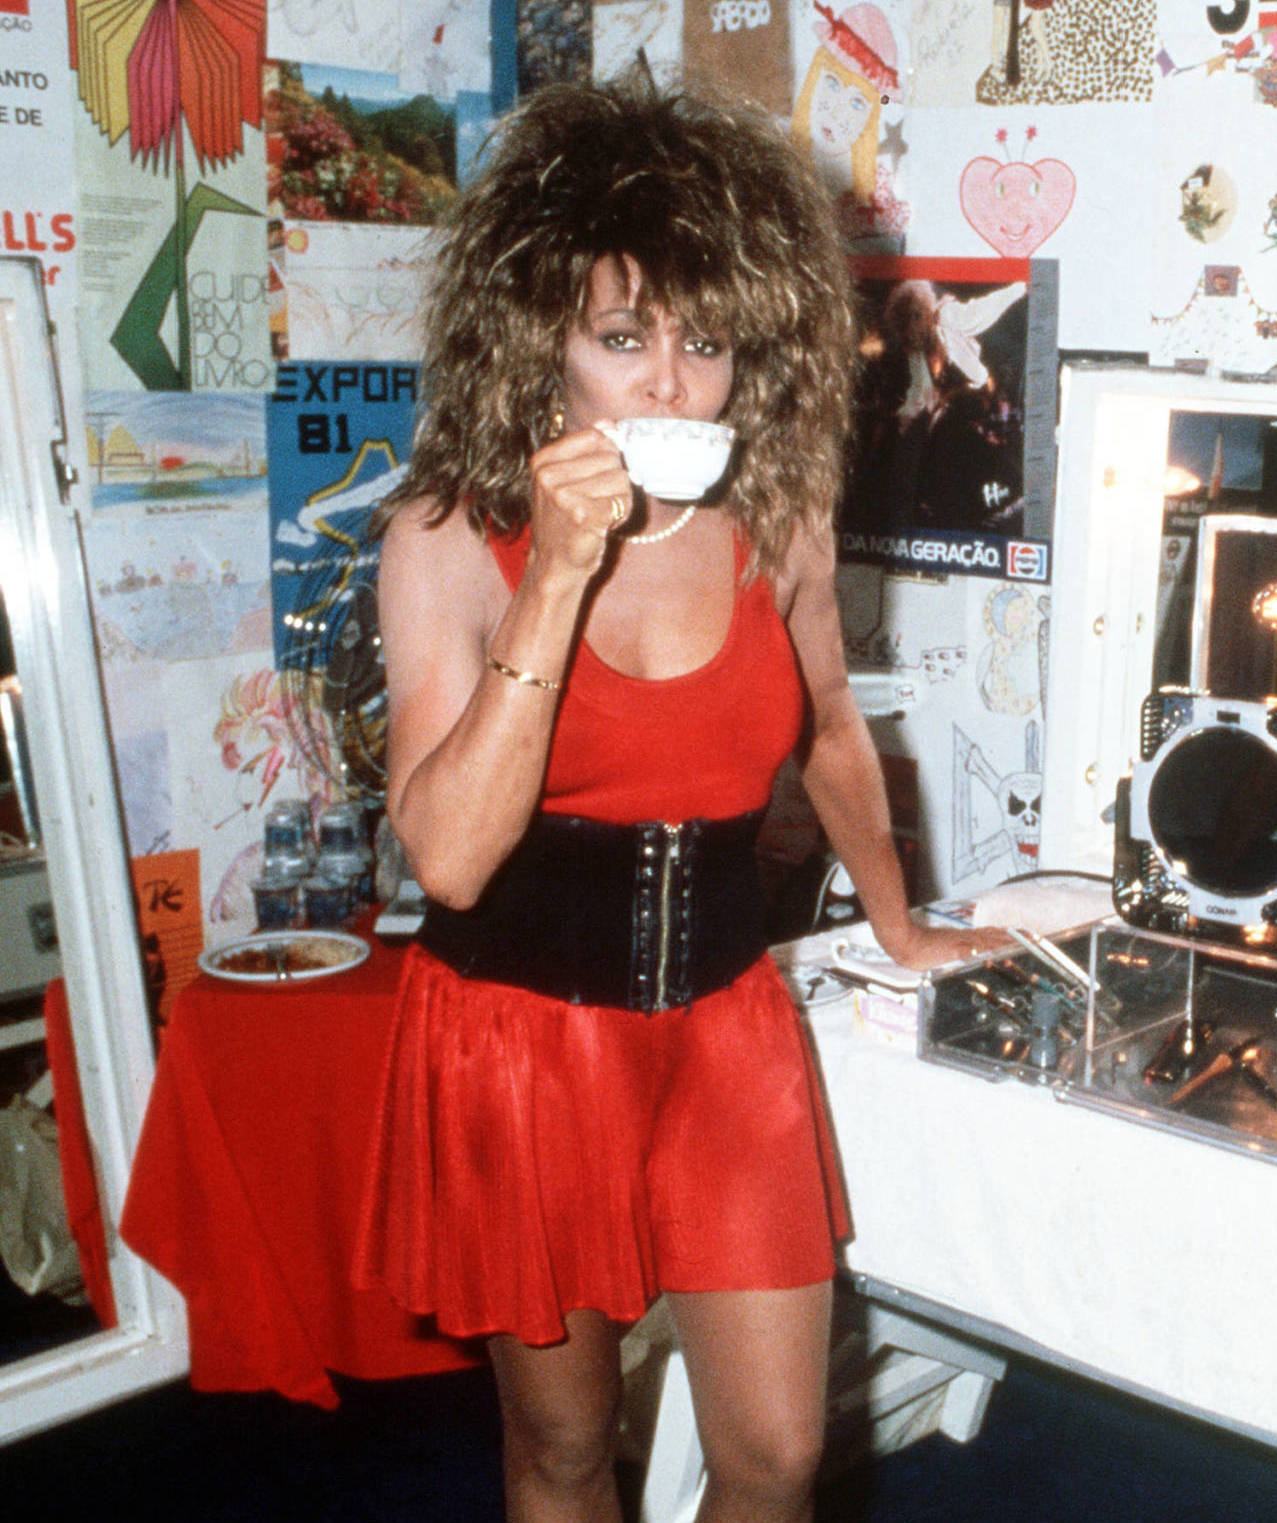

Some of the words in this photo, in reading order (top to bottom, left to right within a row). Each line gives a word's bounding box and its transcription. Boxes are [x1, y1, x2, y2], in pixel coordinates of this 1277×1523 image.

[15, 107, 43, 127] DE
[0, 210, 76, 253] LL'S
[298, 413, 353, 454] 81
[911, 540, 1001, 569] GERAÇÃO.
